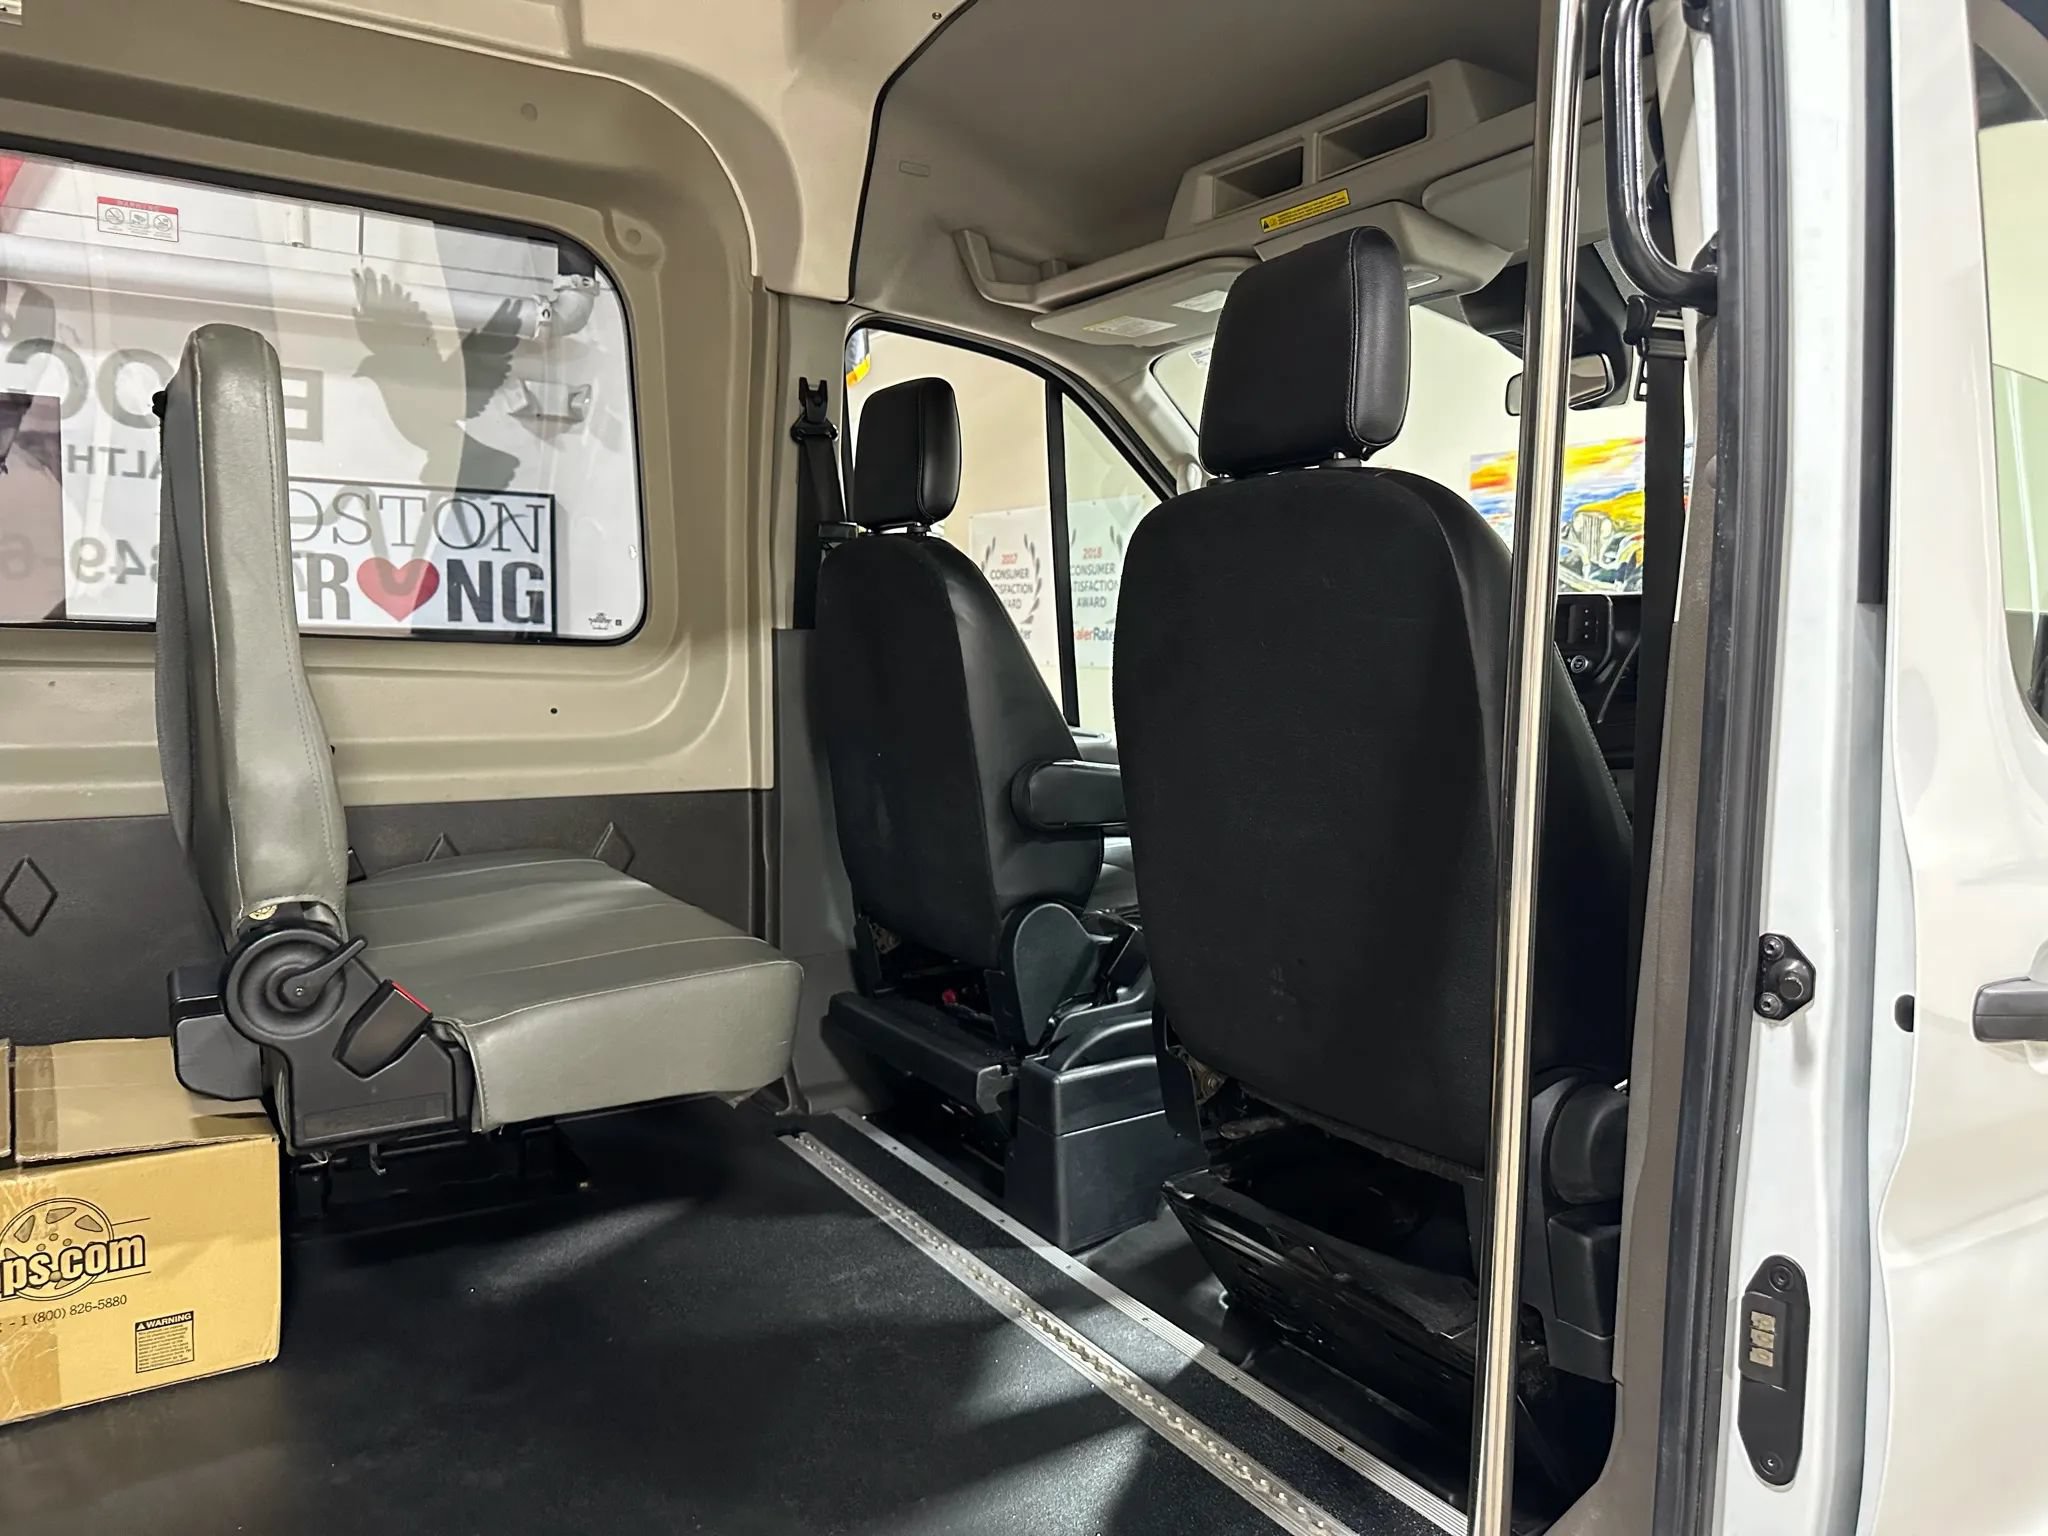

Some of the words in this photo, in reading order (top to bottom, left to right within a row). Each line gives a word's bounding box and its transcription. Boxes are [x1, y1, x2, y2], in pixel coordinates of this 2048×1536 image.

[989, 567, 1030, 580] CONSUMER
[1073, 579, 1119, 592] TISFACTIO
[1076, 596, 1107, 609] AWARD
[32, 1307, 67, 1325] (800)
[69, 1294, 128, 1317] 826-5880
[145, 1312, 192, 1329] WARNING
